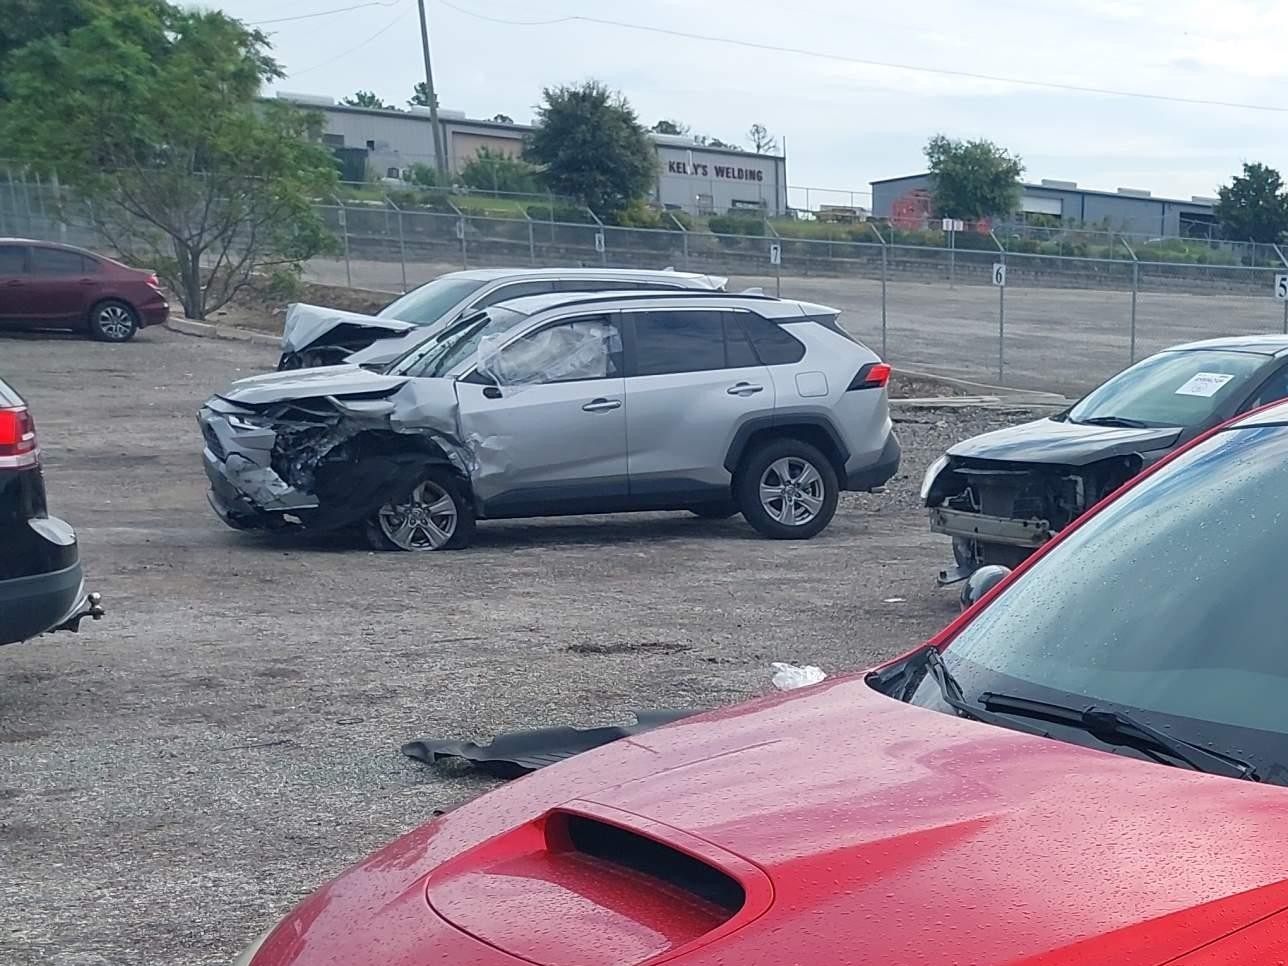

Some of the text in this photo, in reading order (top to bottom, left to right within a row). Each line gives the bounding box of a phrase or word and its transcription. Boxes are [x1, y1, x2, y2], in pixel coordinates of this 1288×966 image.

[714, 165, 763, 181] WELDING
[773, 246, 779, 262] 7
[995, 267, 1003, 284] 6
[1278, 277, 1288, 298] 5
